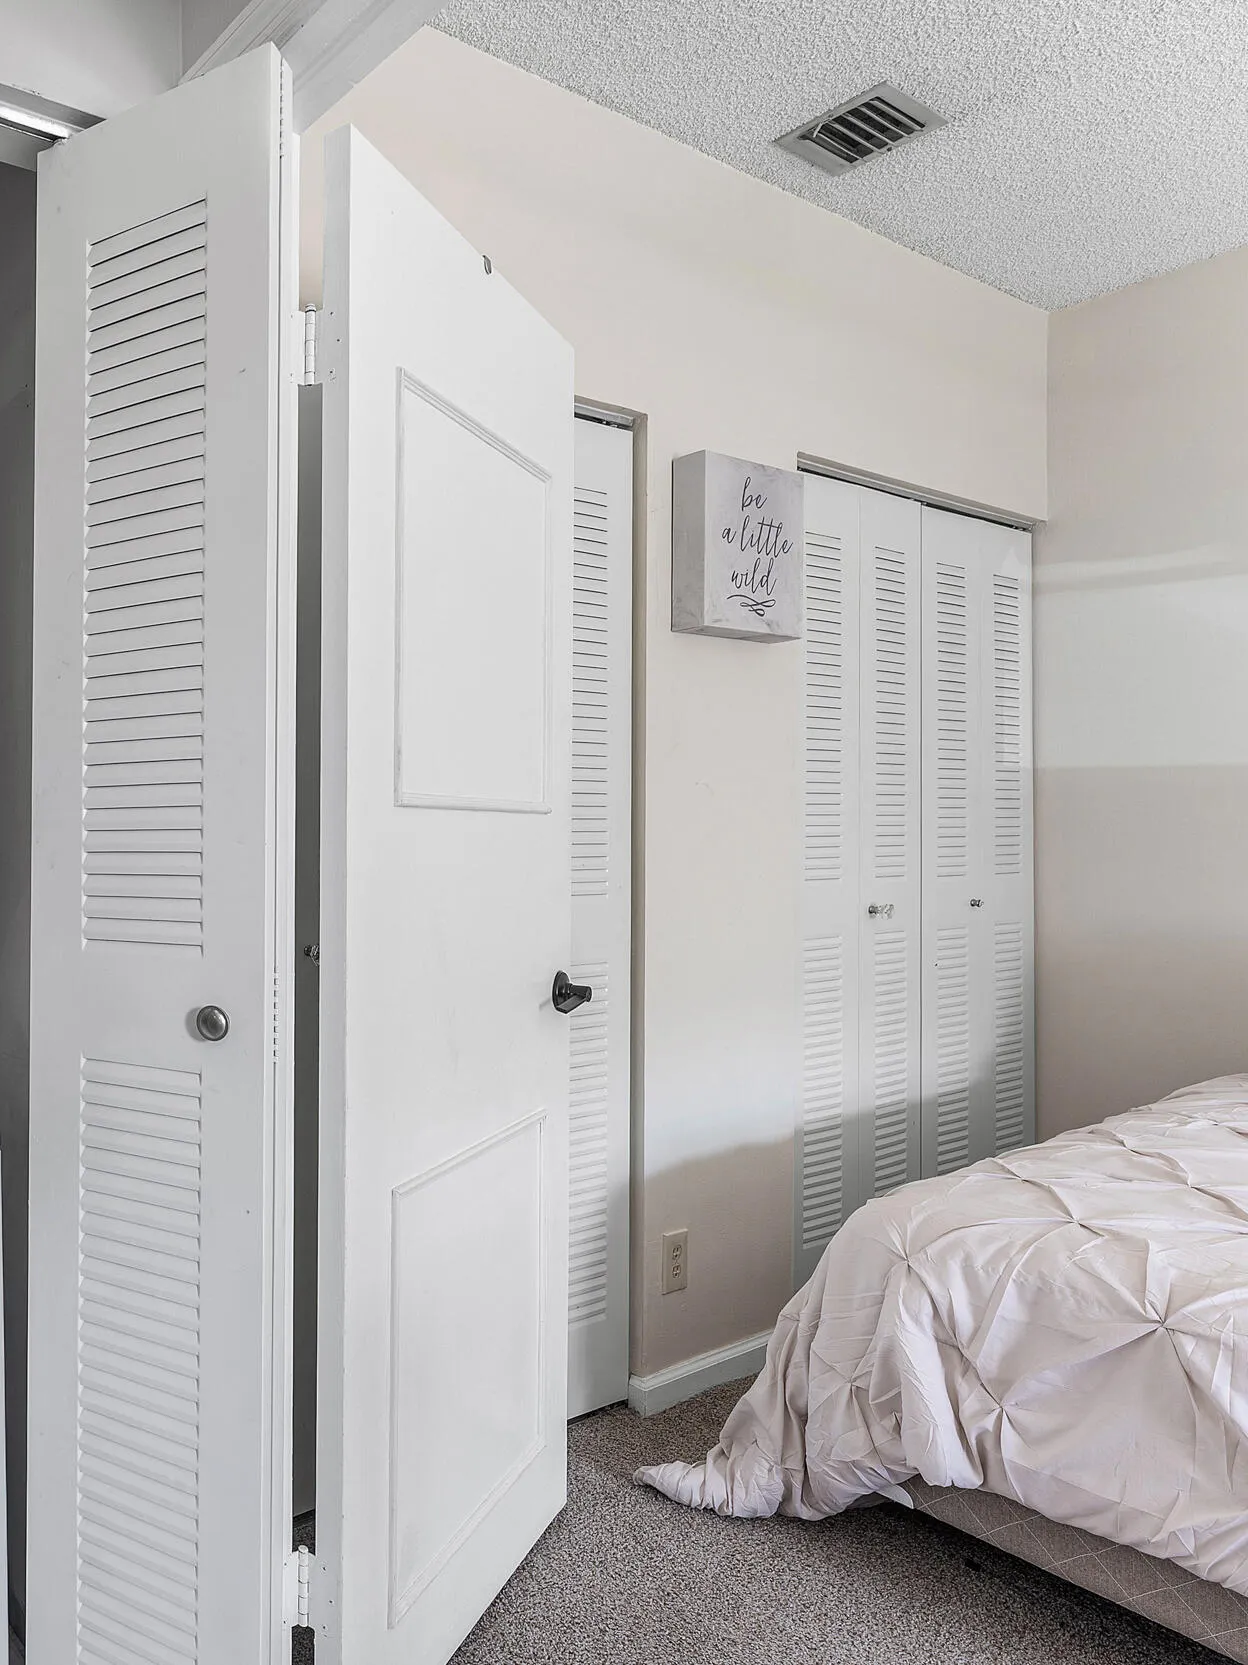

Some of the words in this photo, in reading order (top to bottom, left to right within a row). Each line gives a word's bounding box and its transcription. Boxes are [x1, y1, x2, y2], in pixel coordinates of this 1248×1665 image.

[741, 476, 768, 511] be
[721, 526, 737, 544] a
[740, 515, 794, 558] little
[731, 557, 777, 596] wild
